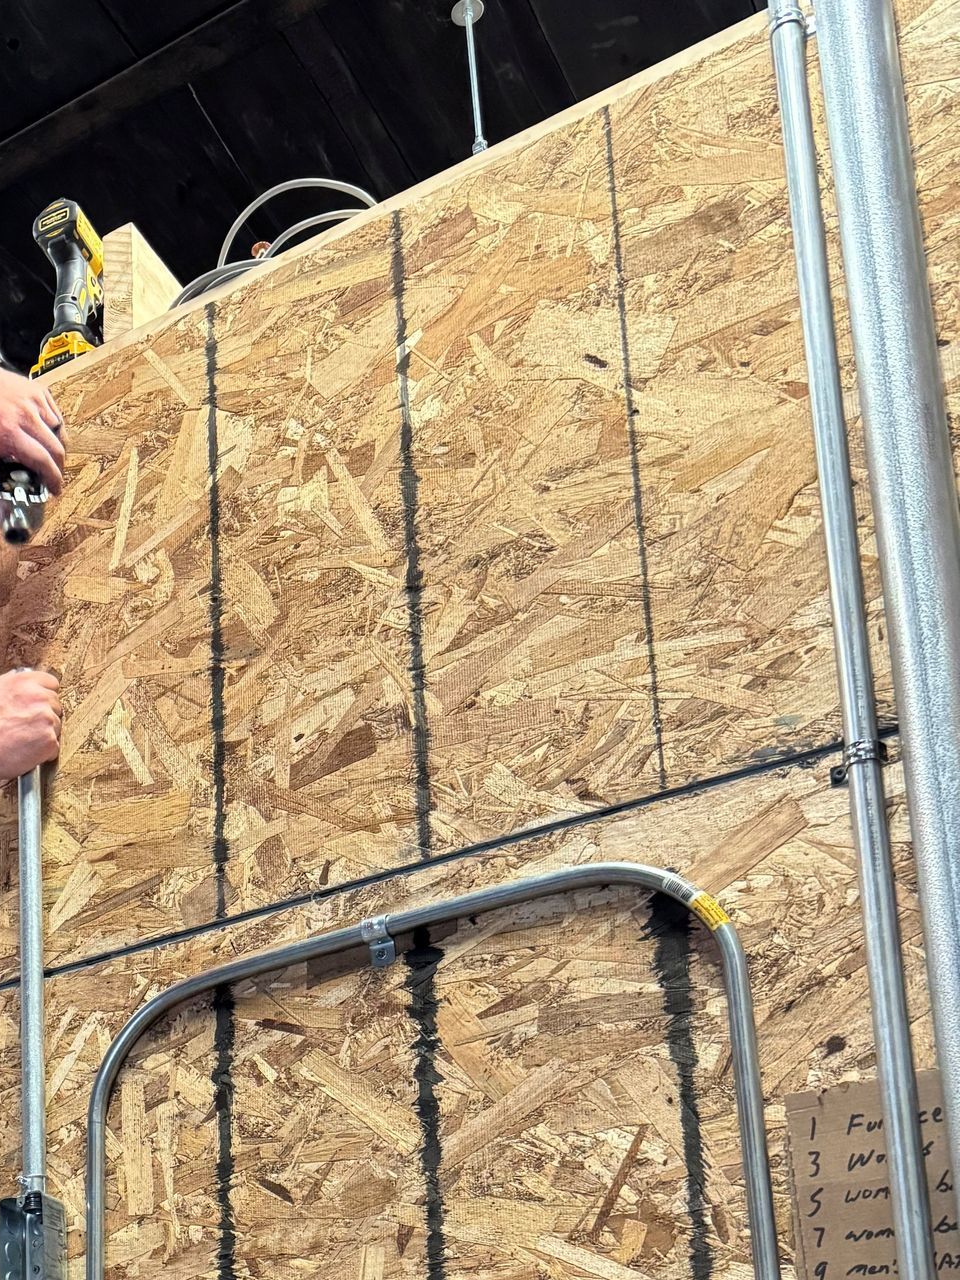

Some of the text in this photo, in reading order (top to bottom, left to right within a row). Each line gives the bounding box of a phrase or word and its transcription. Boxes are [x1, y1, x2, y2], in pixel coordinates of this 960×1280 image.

[810, 1117, 816, 1140] 1
[808, 1151, 820, 1177] 3
[808, 1188, 824, 1217] 5
[813, 1228, 824, 1247] 7
